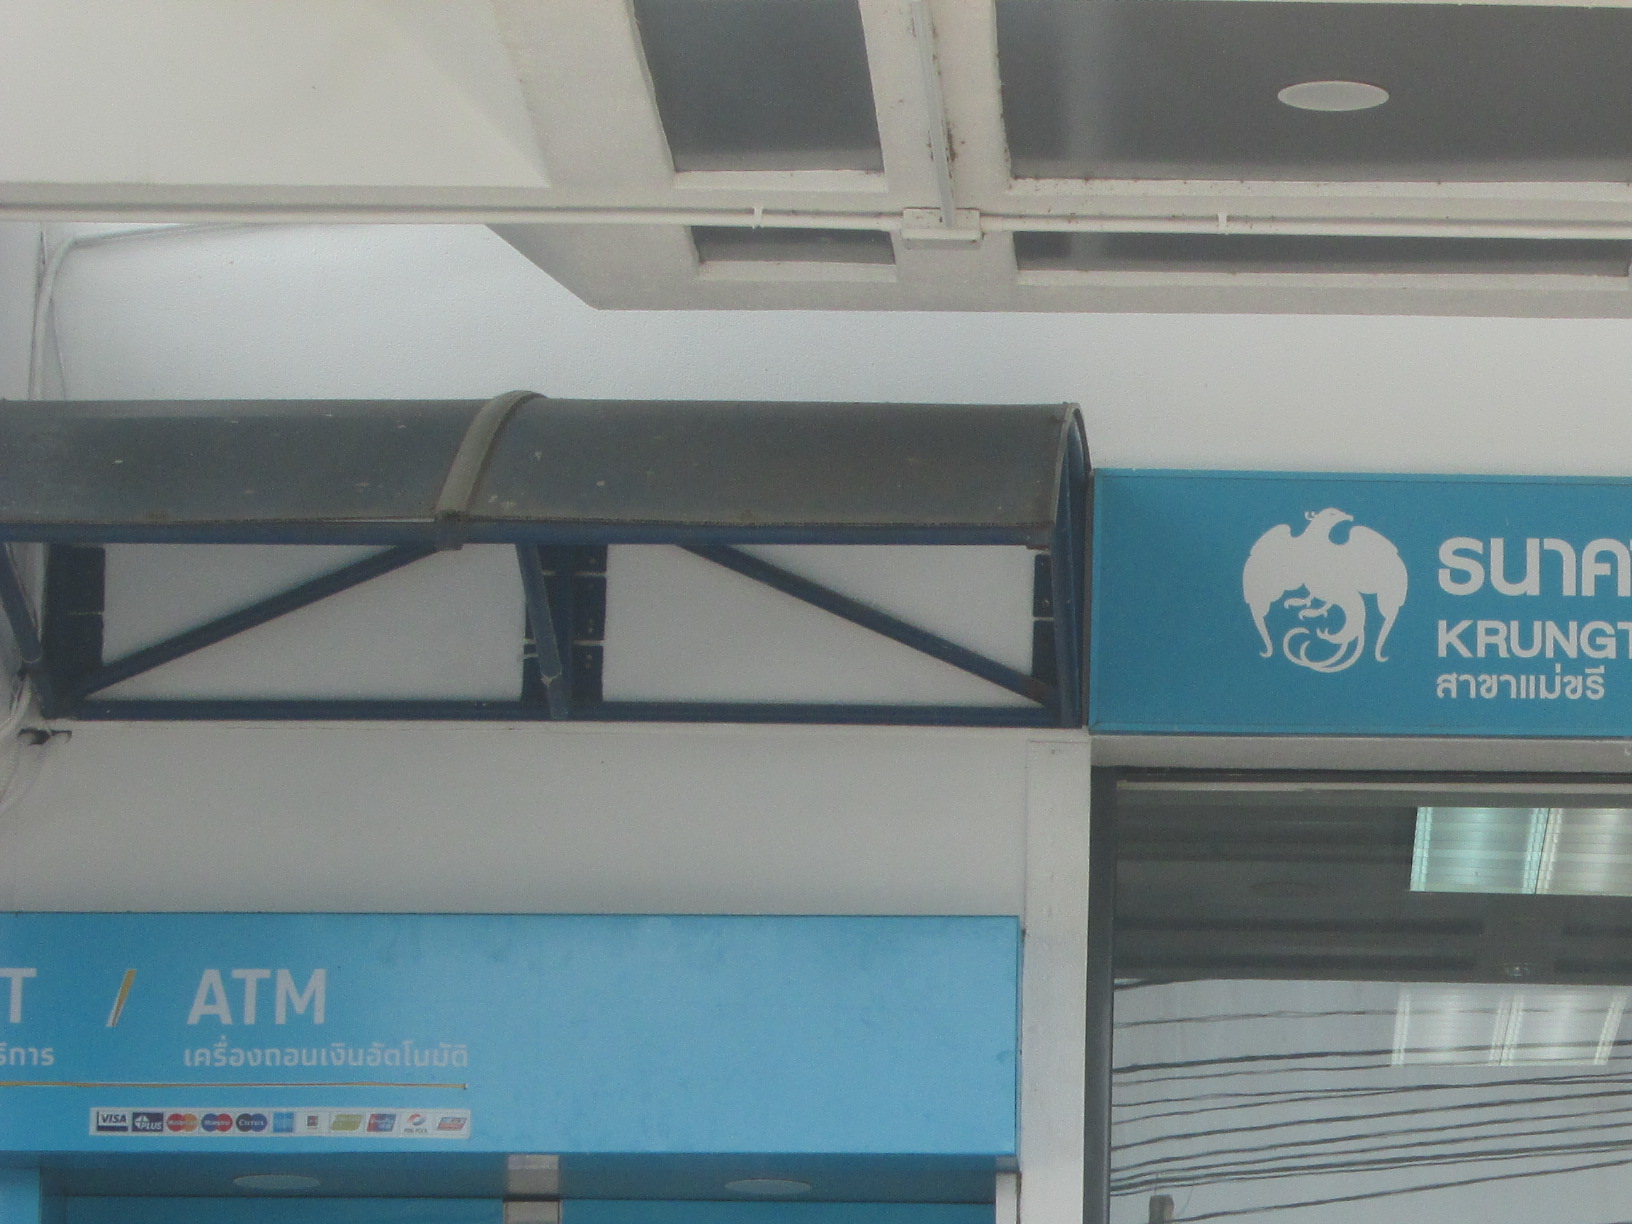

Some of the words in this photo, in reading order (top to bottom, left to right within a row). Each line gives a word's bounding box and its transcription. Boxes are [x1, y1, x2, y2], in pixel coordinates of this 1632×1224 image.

[1437, 664, 1605, 700] สาขาแม่ขรี
[187, 969, 327, 1024] ATM
[183, 1035, 468, 1067] เครื่องถอนเงินอัตโนมัติ
[101, 1114, 128, 1123] VISA
[141, 1122, 162, 1130] PLUS
